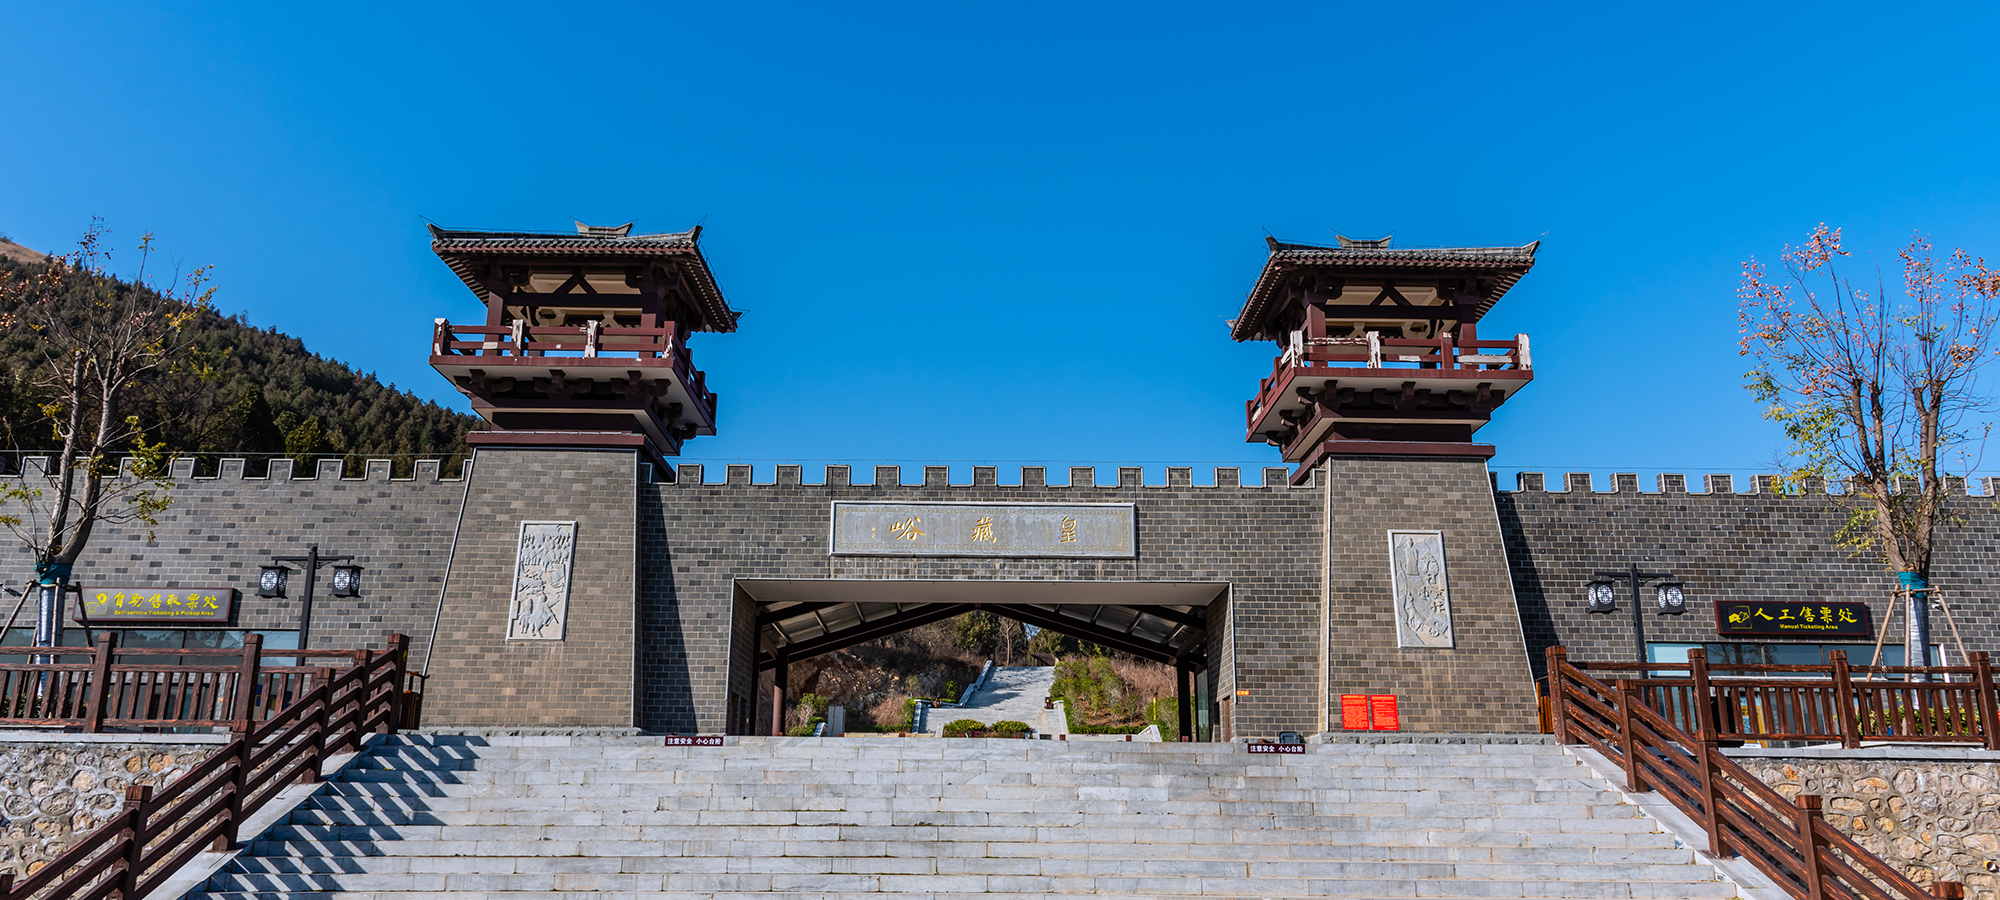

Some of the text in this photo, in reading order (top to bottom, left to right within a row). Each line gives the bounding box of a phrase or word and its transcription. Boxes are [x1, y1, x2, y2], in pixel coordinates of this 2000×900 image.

[112, 591, 220, 610] 自助售取票处
[1753, 606, 1858, 624] 人工售票处
[667, 737, 721, 745] 注意安全 小心台阶
[1250, 745, 1303, 753] 注意安全 小心台阶
